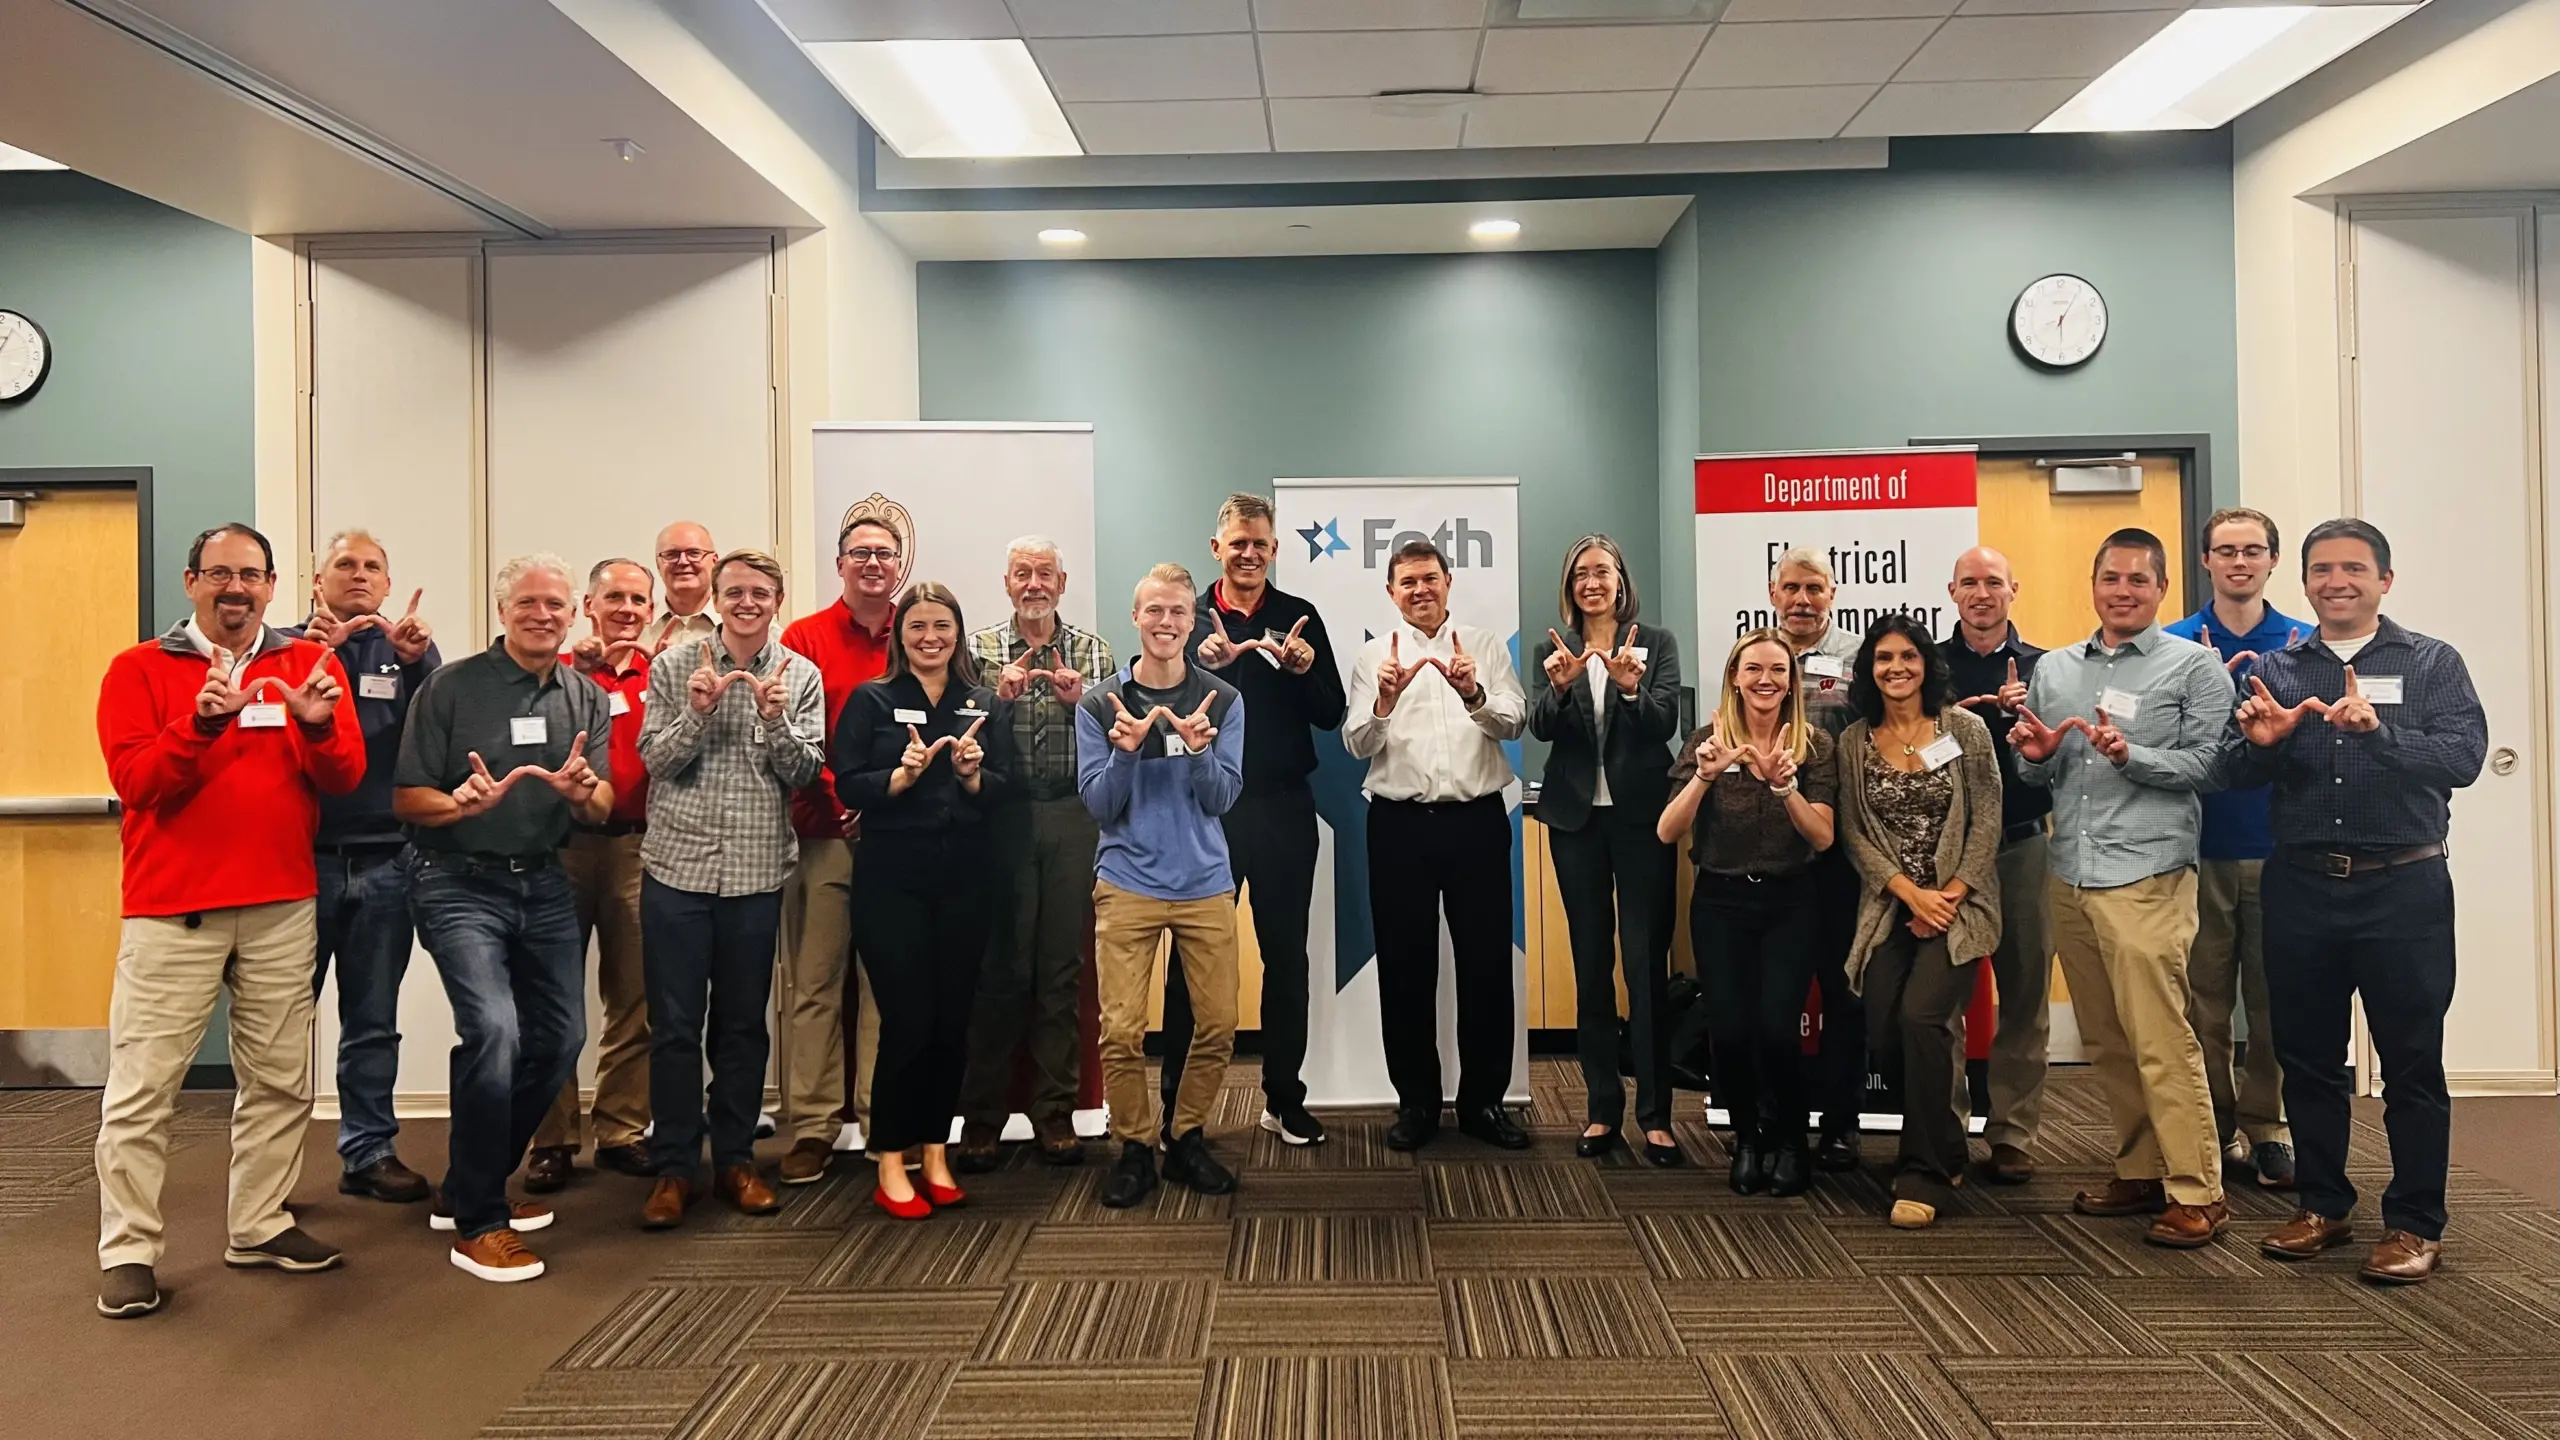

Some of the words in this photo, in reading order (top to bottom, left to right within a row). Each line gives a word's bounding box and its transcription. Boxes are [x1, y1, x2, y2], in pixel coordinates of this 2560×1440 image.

[1764, 473, 1881, 506] Department
[1888, 469, 1908, 500] of
[1767, 539, 1907, 585] Etrical
[1736, 609, 1778, 641] an
